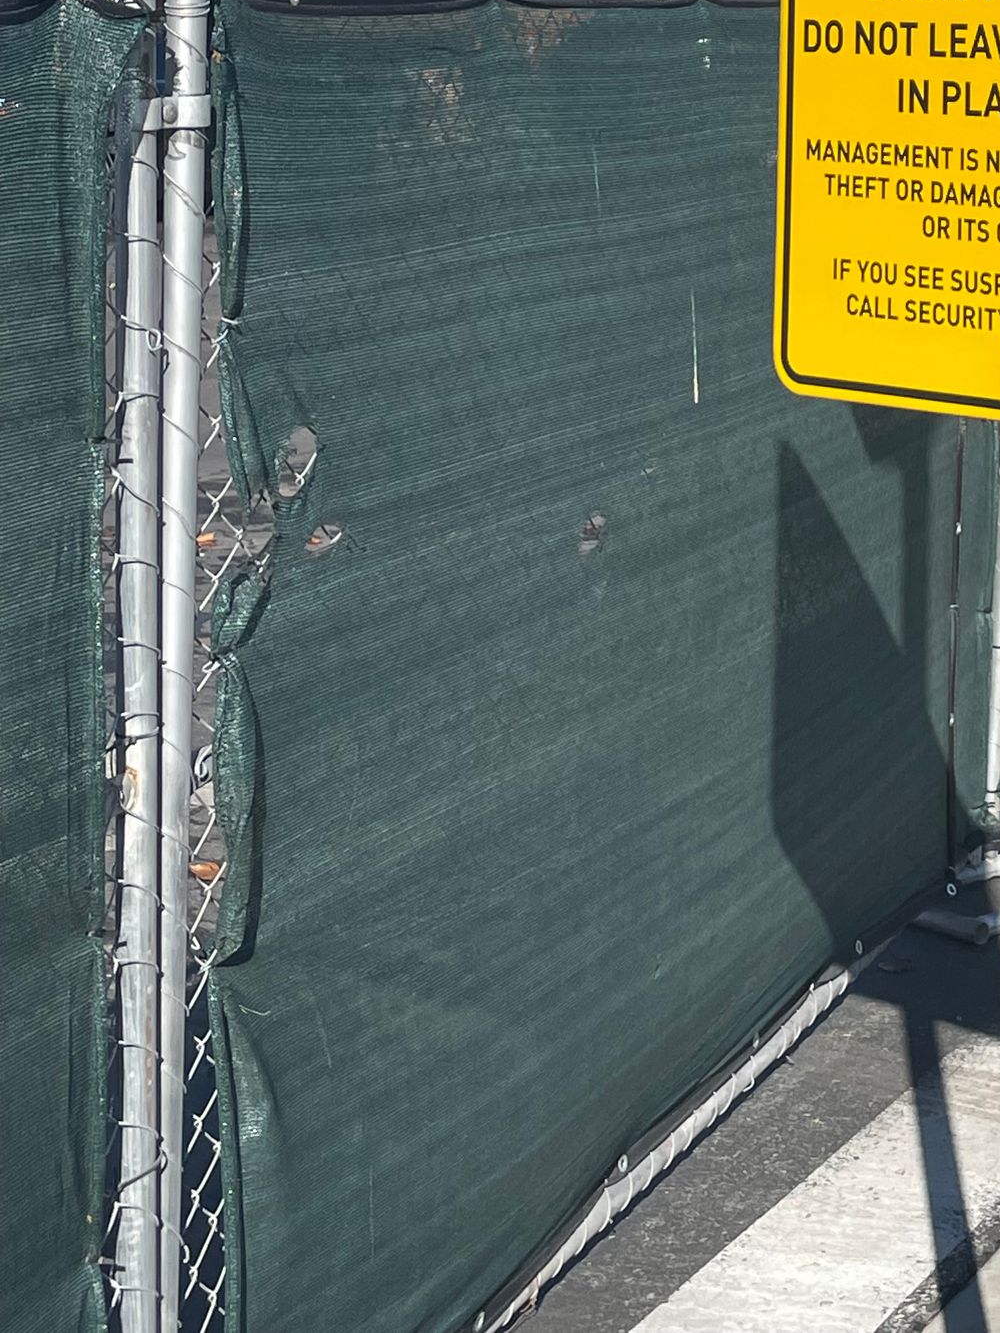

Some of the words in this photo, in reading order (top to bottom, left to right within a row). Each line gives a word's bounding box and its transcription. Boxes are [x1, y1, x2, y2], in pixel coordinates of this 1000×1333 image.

[803, 19, 844, 54] DO
[855, 20, 918, 57] NOT
[898, 78, 929, 114] IN
[806, 139, 953, 169] MANAGEMENT
[960, 148, 979, 171] IS
[825, 174, 890, 199] THEFT
[896, 179, 923, 202] OR
[922, 215, 950, 239] OR
[957, 218, 990, 243] ITS
[833, 259, 851, 280] IF
[857, 261, 897, 285] YOU
[904, 265, 944, 290] SEE
[847, 294, 898, 320] CALL
